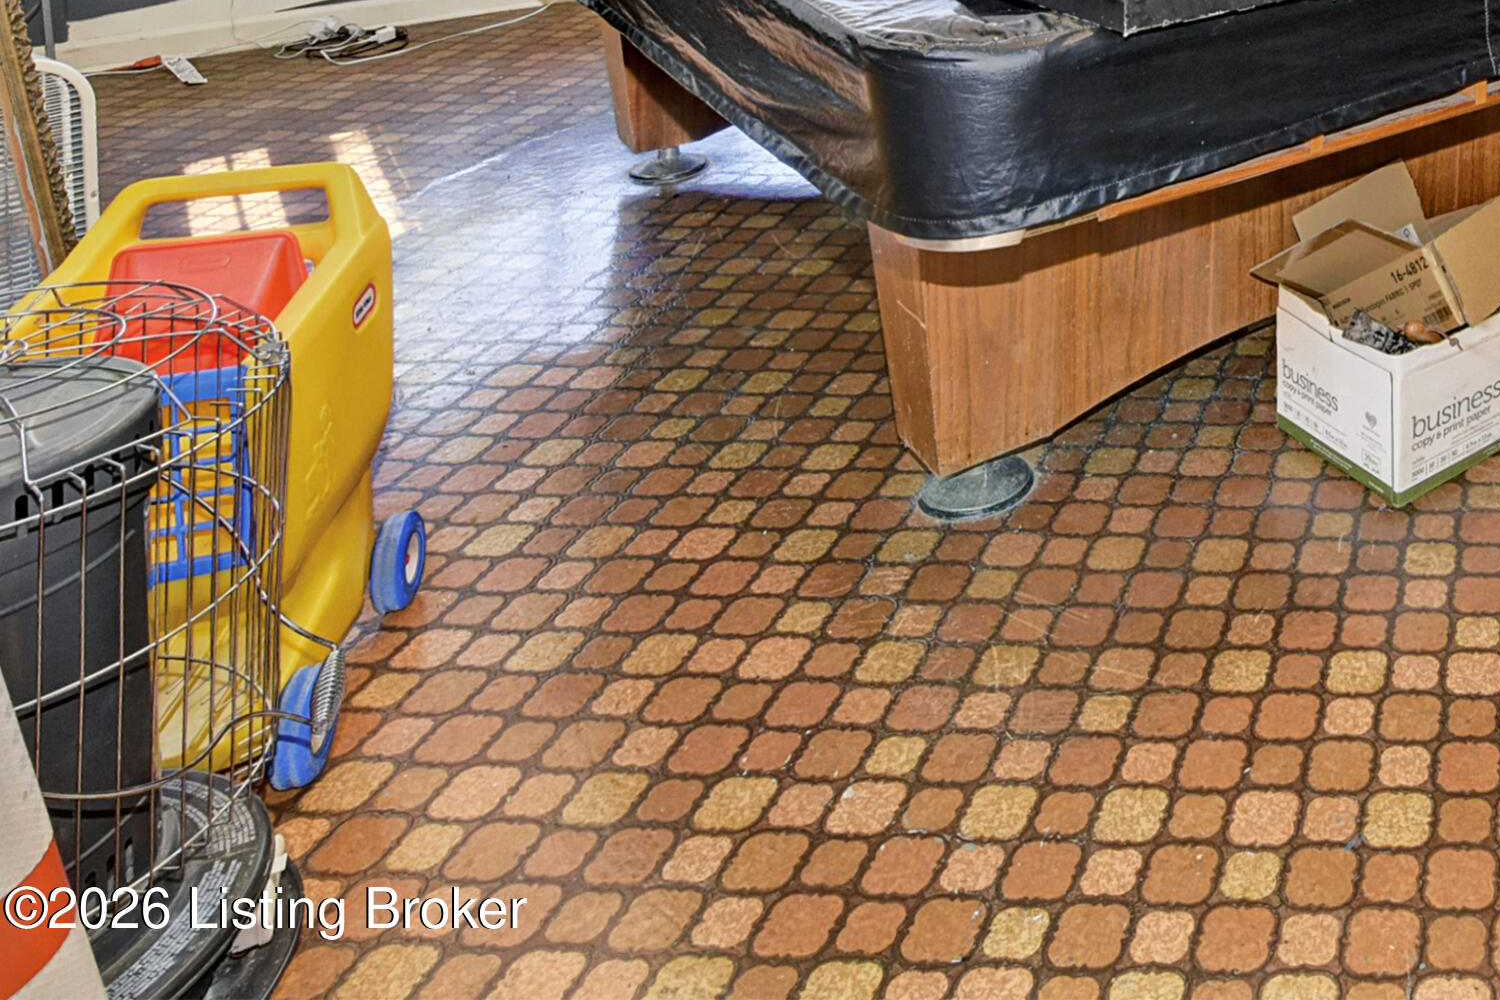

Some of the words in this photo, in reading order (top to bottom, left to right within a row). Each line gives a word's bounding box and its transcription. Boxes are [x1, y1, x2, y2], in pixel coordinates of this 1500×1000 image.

[1390, 256, 1429, 283] 16-4812
[1281, 358, 1339, 412] business
[1411, 434, 1436, 452] copy
[1443, 417, 1465, 438] print
[1466, 404, 1491, 425] paper
